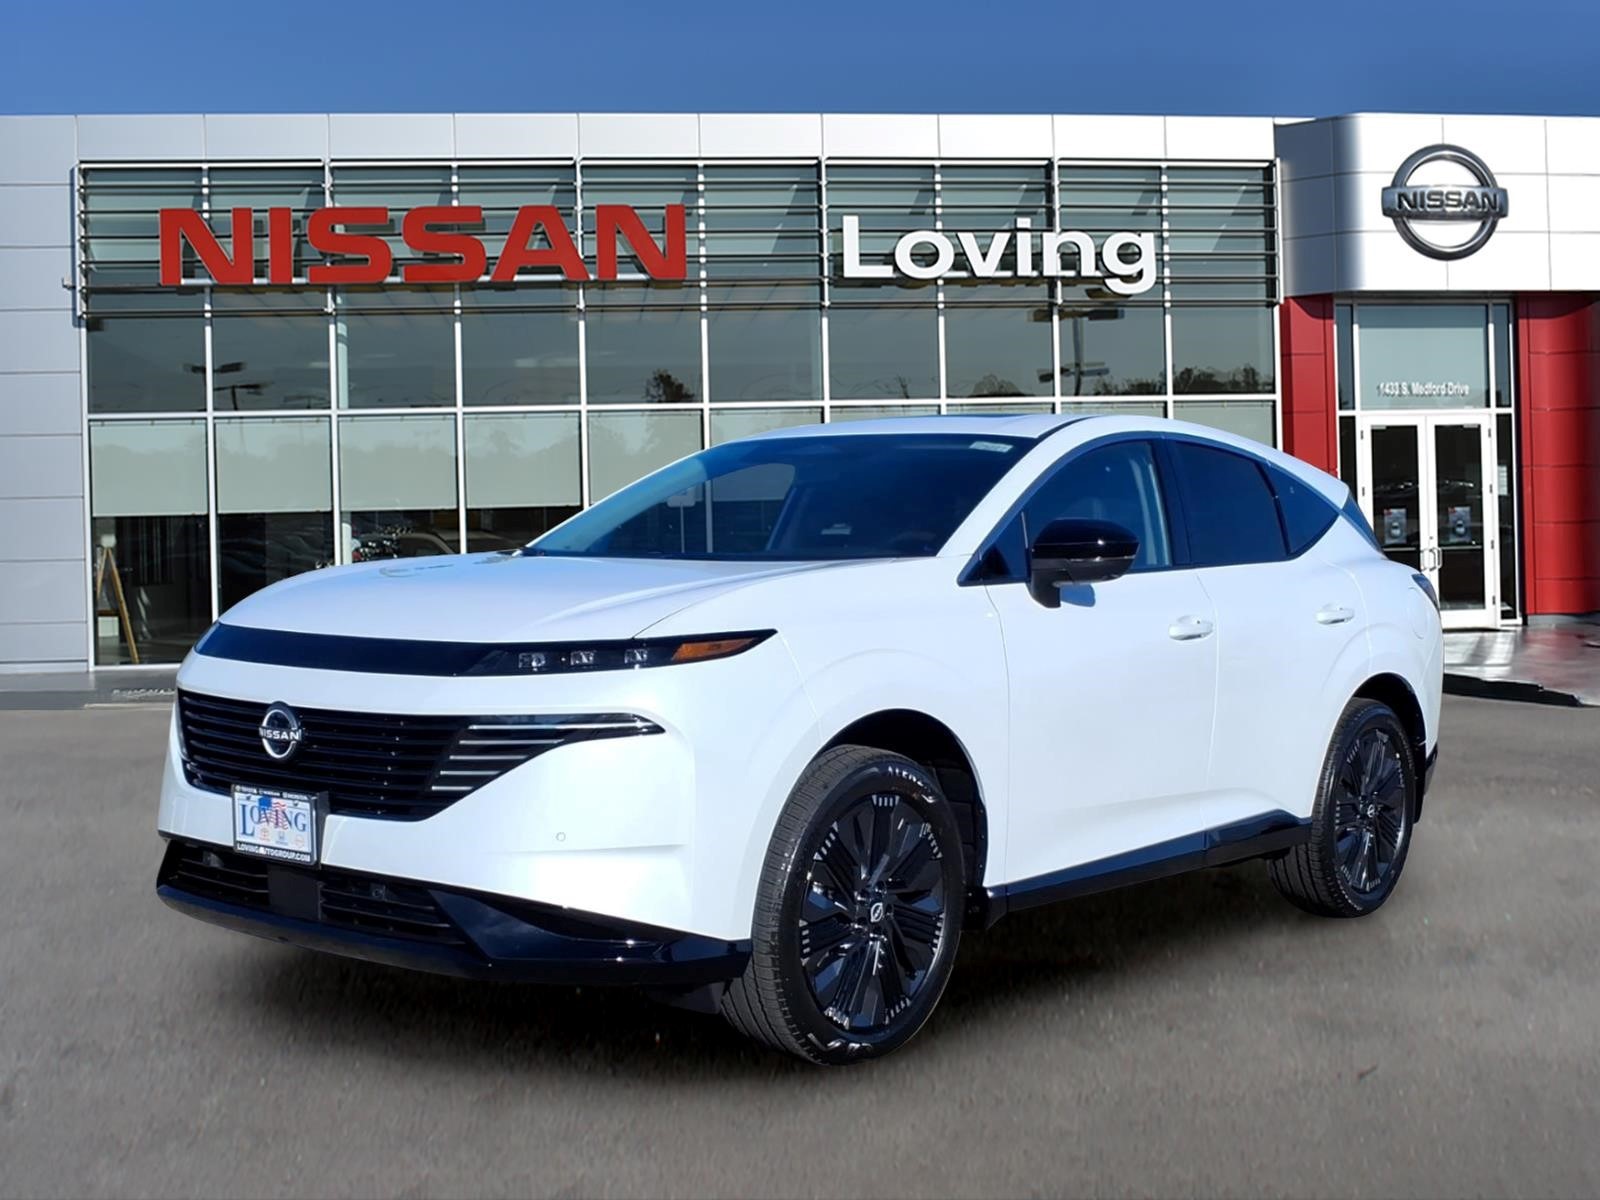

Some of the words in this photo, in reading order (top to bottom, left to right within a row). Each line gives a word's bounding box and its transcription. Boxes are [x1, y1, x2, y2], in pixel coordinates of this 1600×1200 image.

[1397, 191, 1498, 210] NISSAN
[160, 204, 687, 285] NISSAN
[842, 215, 1158, 295] Loving
[1379, 382, 1399, 395] 1433
[1401, 382, 1410, 395] S.
[1412, 382, 1446, 395] Medford
[1447, 382, 1469, 395] Drive
[259, 727, 300, 741] NISSAN
[239, 804, 307, 837] LOVING
